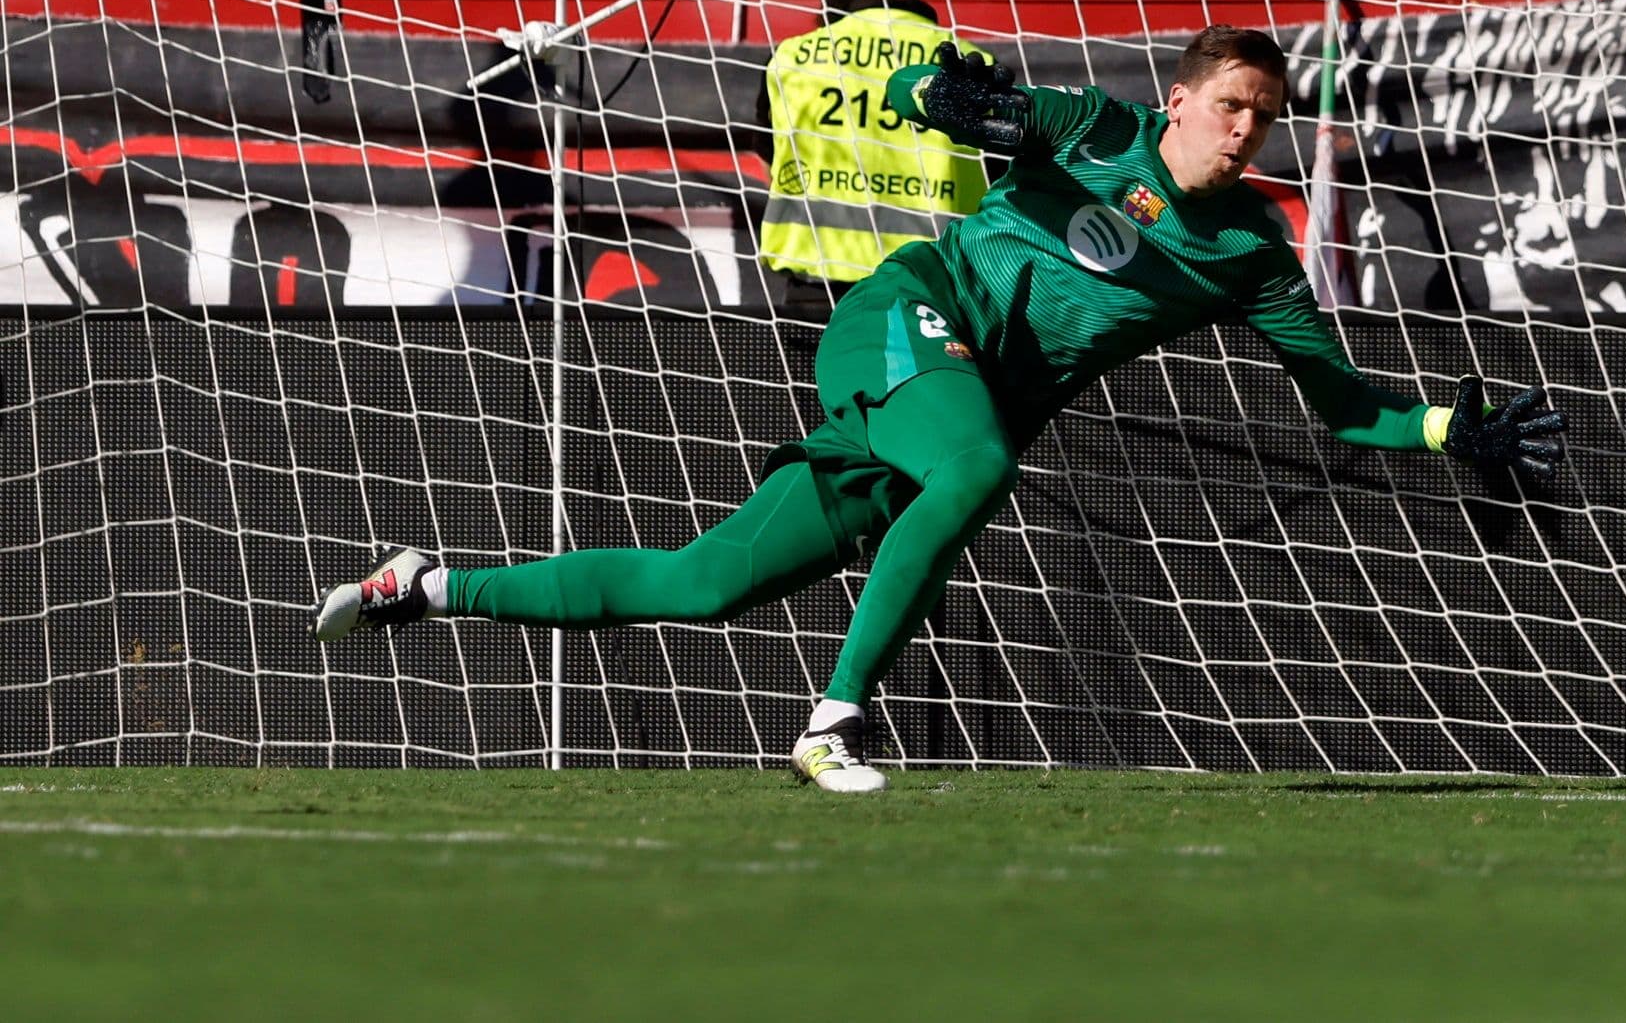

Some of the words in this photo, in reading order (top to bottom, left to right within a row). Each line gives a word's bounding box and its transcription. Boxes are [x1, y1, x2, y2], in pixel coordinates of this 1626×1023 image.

[795, 35, 945, 70] SEGURIDA
[818, 87, 929, 133] 215
[818, 169, 957, 201] PROSEGUR
